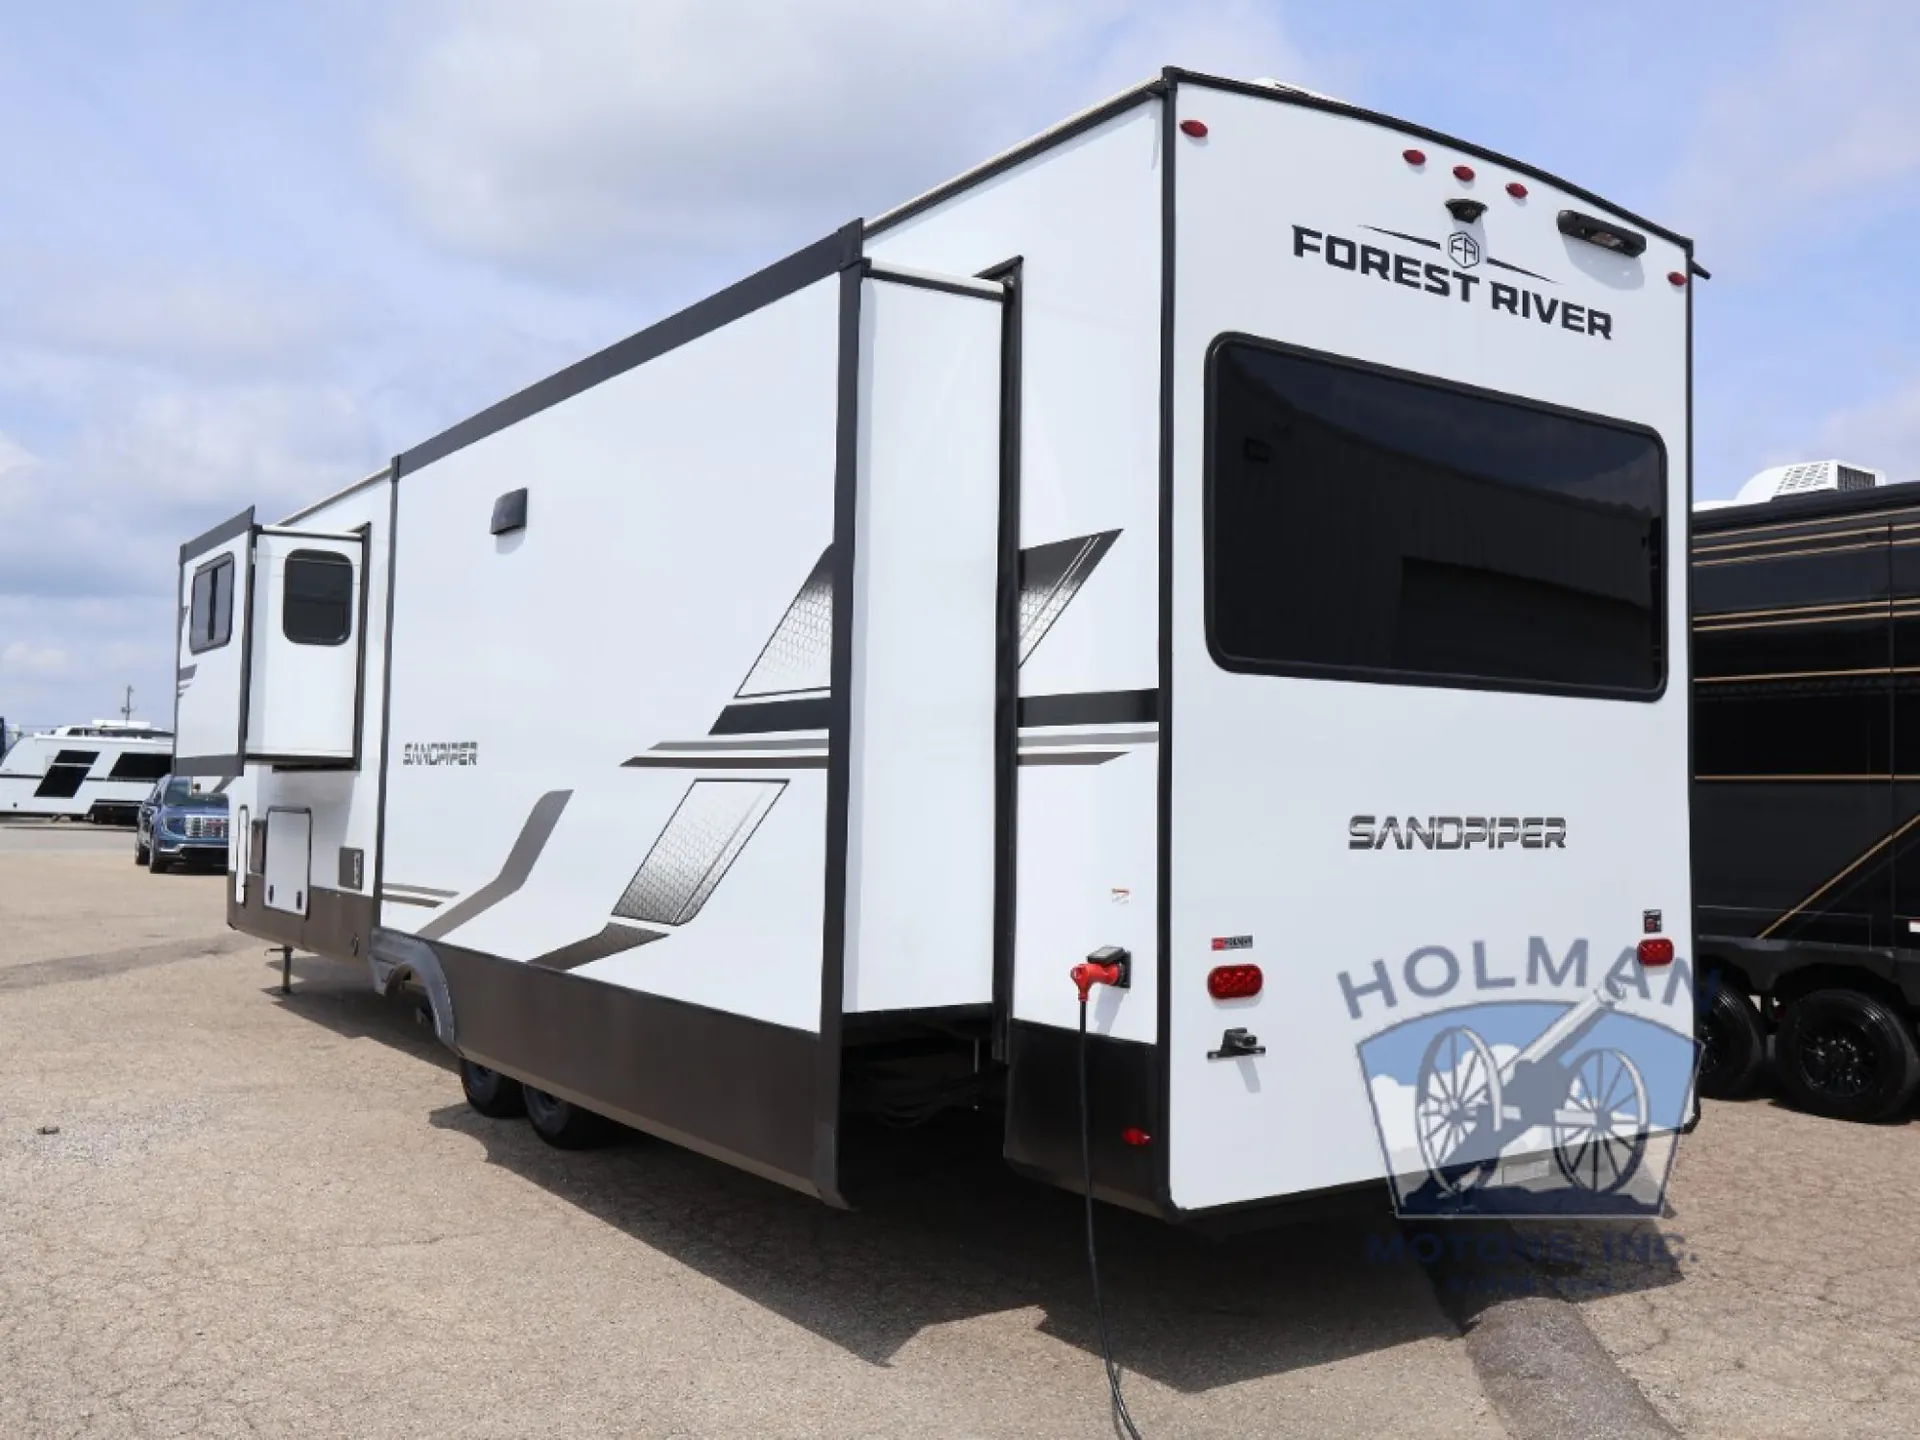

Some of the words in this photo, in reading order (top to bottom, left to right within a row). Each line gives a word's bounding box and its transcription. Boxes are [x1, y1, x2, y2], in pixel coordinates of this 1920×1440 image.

[1292, 224, 1480, 302] FOREST
[1490, 281, 1612, 340] RIVER
[403, 742, 476, 765] SANDPIPER
[1348, 815, 1567, 850] SANDPIPER
